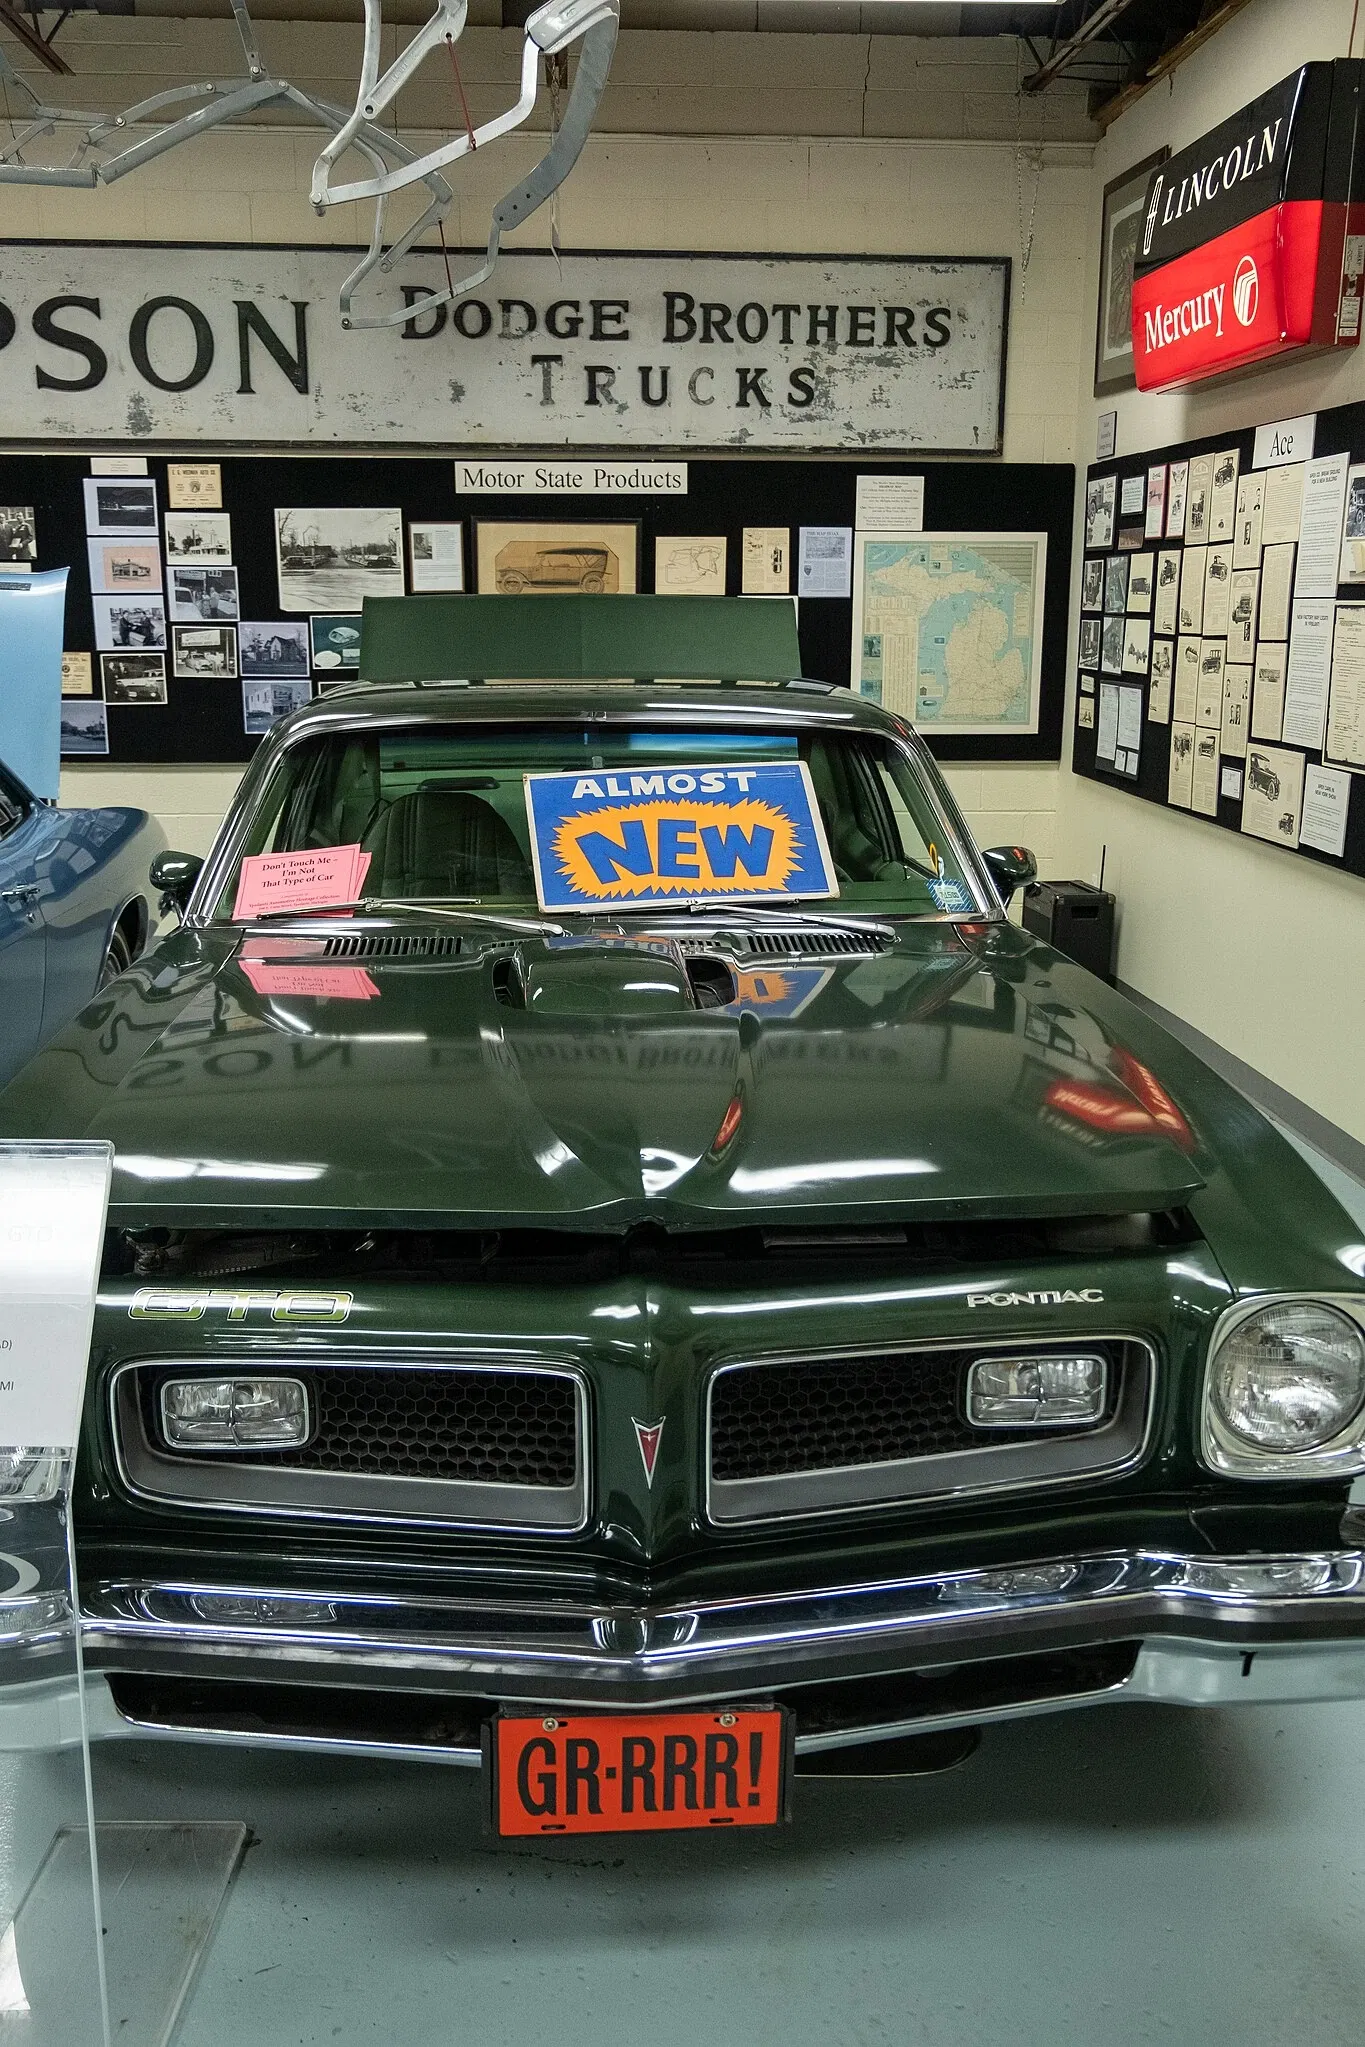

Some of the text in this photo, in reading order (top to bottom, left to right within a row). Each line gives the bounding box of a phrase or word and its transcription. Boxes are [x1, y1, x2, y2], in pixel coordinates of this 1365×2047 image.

[1161, 118, 1282, 226] LINCOLN
[400, 286, 952, 348] DODGE BROTHERS
[1144, 282, 1225, 354] Mercury
[531, 354, 816, 408] TRUCKS
[1270, 430, 1294, 457] Ace
[462, 468, 682, 488] Motor State Products
[572, 771, 757, 799] ALMOST
[262, 862, 286, 872] Don't
[289, 858, 315, 868] Touch
[317, 857, 331, 865] Me
[575, 818, 775, 885] NEW
[261, 873, 334, 888] That Type of Car
[282, 869, 297, 877] I'm
[128, 1286, 354, 1324] GTO
[966, 1288, 1105, 1308] PONTIAC
